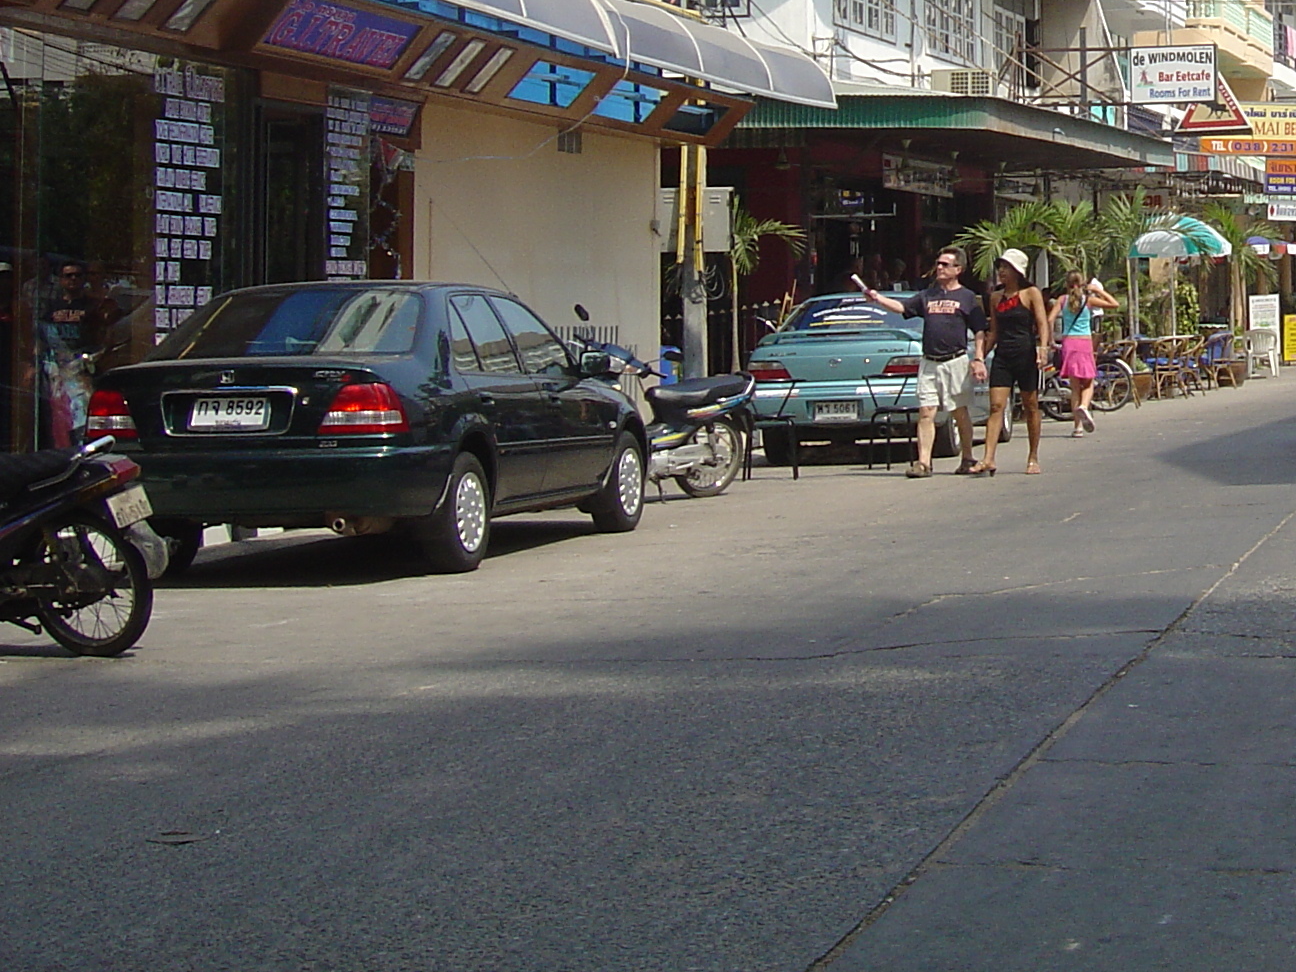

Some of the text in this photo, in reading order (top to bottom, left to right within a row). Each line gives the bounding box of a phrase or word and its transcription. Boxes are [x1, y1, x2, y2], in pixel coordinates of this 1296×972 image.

[1132, 51, 1212, 66] de WINDMOLEN
[1158, 69, 1211, 82] Bar Eetcafe
[1149, 86, 1211, 98] Rooms For Rent
[1254, 121, 1280, 135] MAI
[226, 399, 264, 416] 8592
